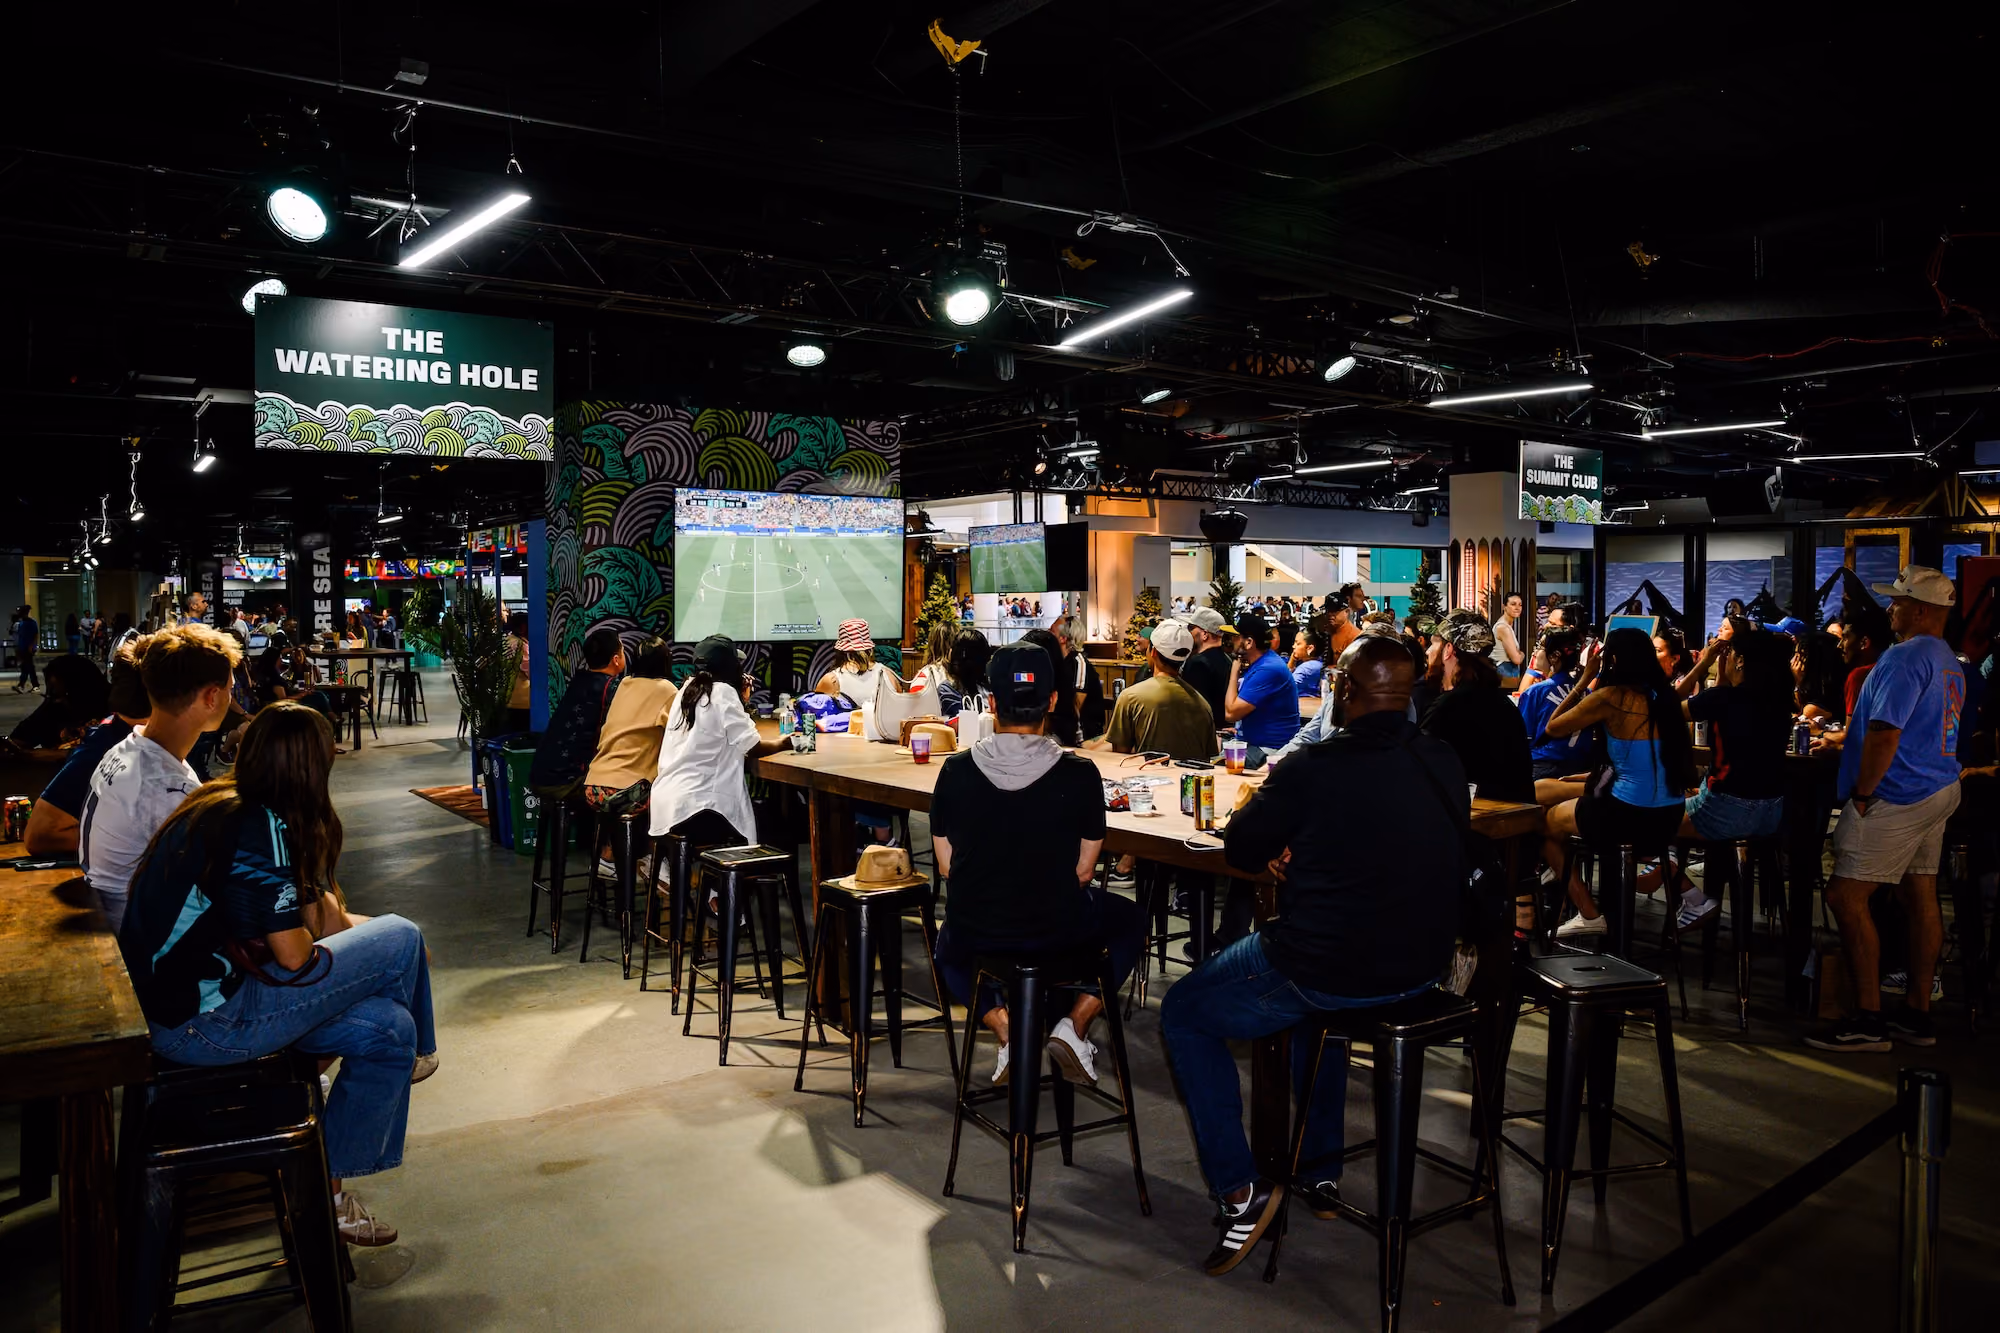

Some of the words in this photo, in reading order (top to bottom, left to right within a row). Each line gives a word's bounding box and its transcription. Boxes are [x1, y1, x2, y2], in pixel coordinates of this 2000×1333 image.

[382, 327, 444, 355] THE
[275, 348, 452, 385] WATERING
[459, 363, 538, 391] HOLE
[1554, 453, 1574, 470] THE
[1526, 469, 1570, 487] SUMMIT
[1572, 474, 1598, 490] CLUB
[312, 546, 332, 593] SEA
[313, 599, 332, 635] RE
